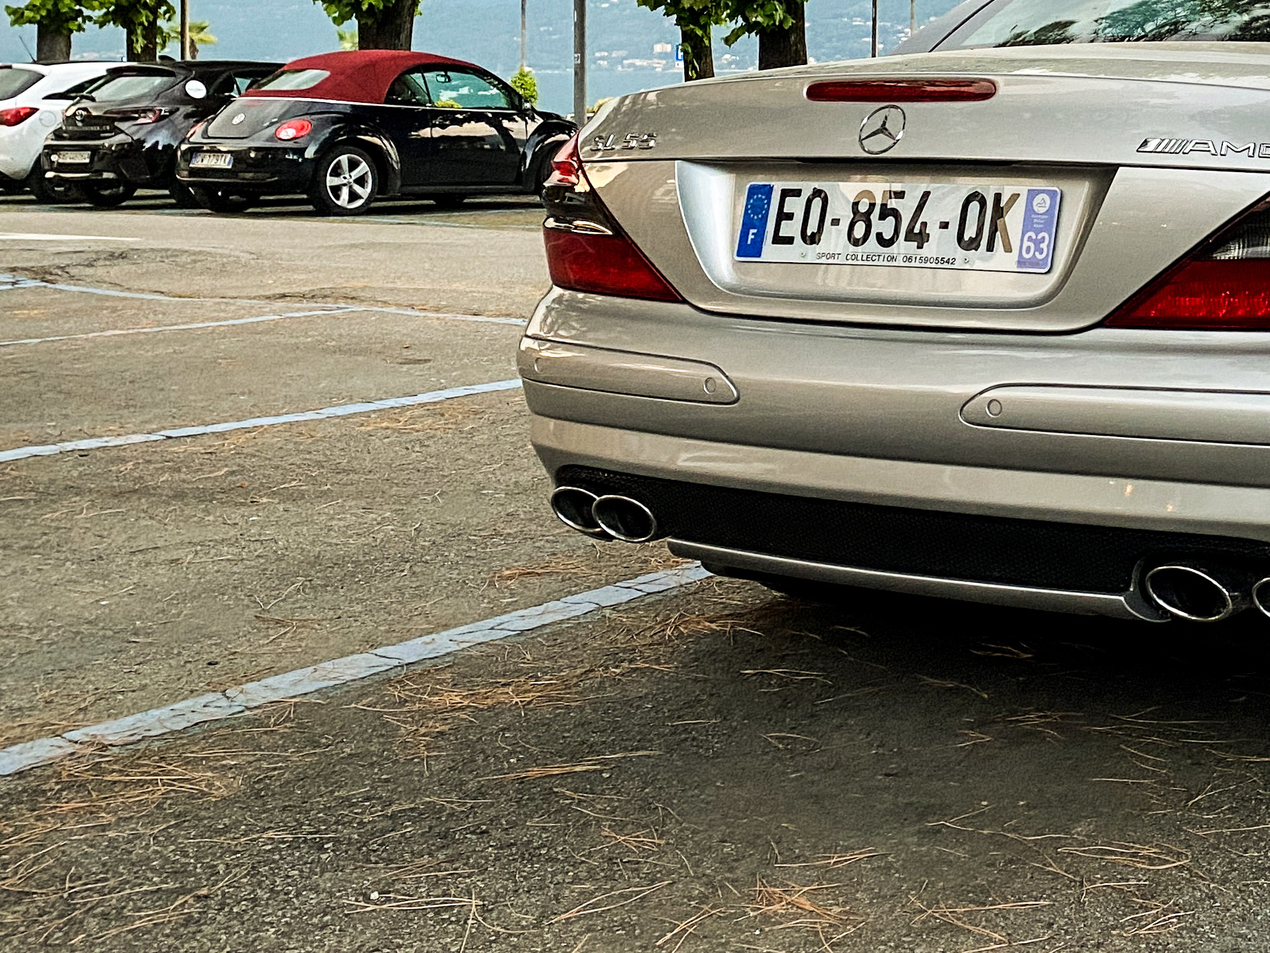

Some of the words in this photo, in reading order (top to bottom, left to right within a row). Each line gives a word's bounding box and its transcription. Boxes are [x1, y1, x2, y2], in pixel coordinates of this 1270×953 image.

[590, 133, 616, 152] SL
[621, 132, 658, 151] 55
[745, 229, 756, 246] F
[1021, 231, 1050, 259] 63
[816, 252, 842, 261] SPORT
[845, 253, 898, 263] COLLECTION
